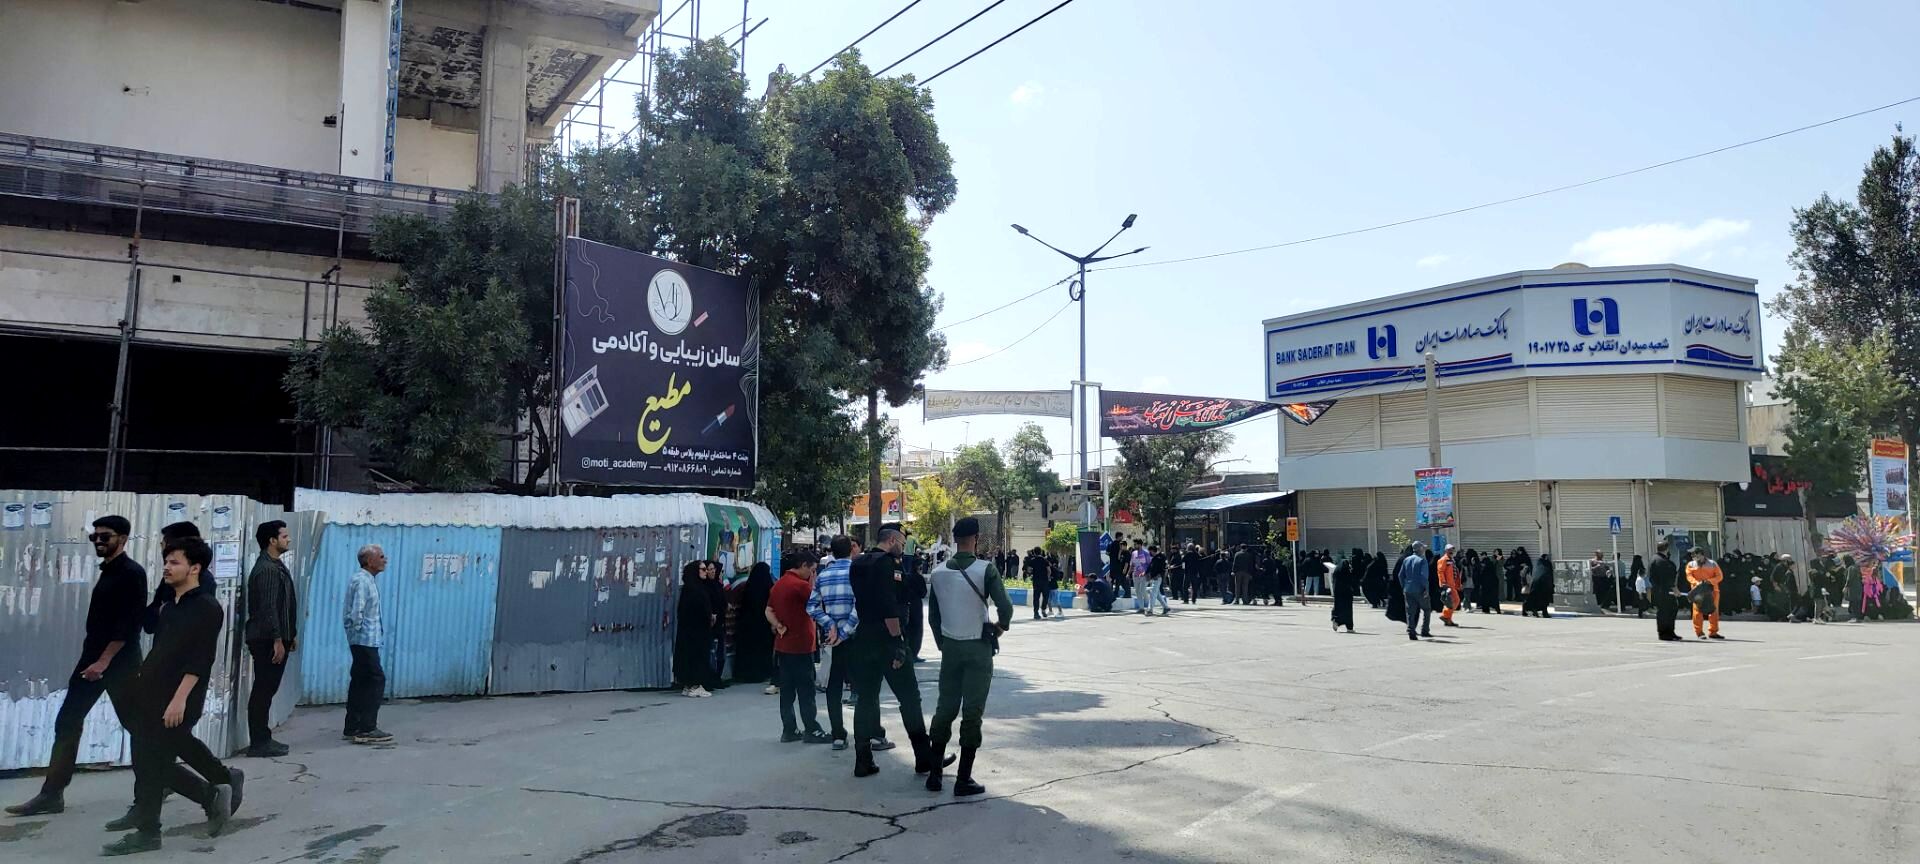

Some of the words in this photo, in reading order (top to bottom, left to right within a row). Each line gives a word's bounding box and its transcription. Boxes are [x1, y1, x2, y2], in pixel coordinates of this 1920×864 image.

[1439, 323, 1480, 342] صادرات
[1480, 307, 1511, 339] بانک
[1684, 312, 1702, 335] ایران
[1702, 315, 1732, 332] صادرات
[1732, 309, 1751, 342] بانک
[592, 330, 648, 354] آکادمی
[649, 342, 658, 360] و
[1416, 330, 1438, 353] ایران
[1572, 342, 1585, 353] کد
[1588, 339, 1619, 356] انقلاب
[1620, 340, 1647, 355] میدان
[1648, 338, 1670, 353] شعبه
[660, 339, 705, 367] زیبایی
[706, 345, 740, 368] سالن
[1276, 350, 1296, 365] BANK
[1297, 344, 1334, 361] SADERAT
[1335, 340, 1356, 356] IRAN
[637, 372, 692, 455] مطیع
[662, 446, 668, 455] ۵
[668, 446, 680, 458] طبقه
[727, 466, 742, 477] شماره
